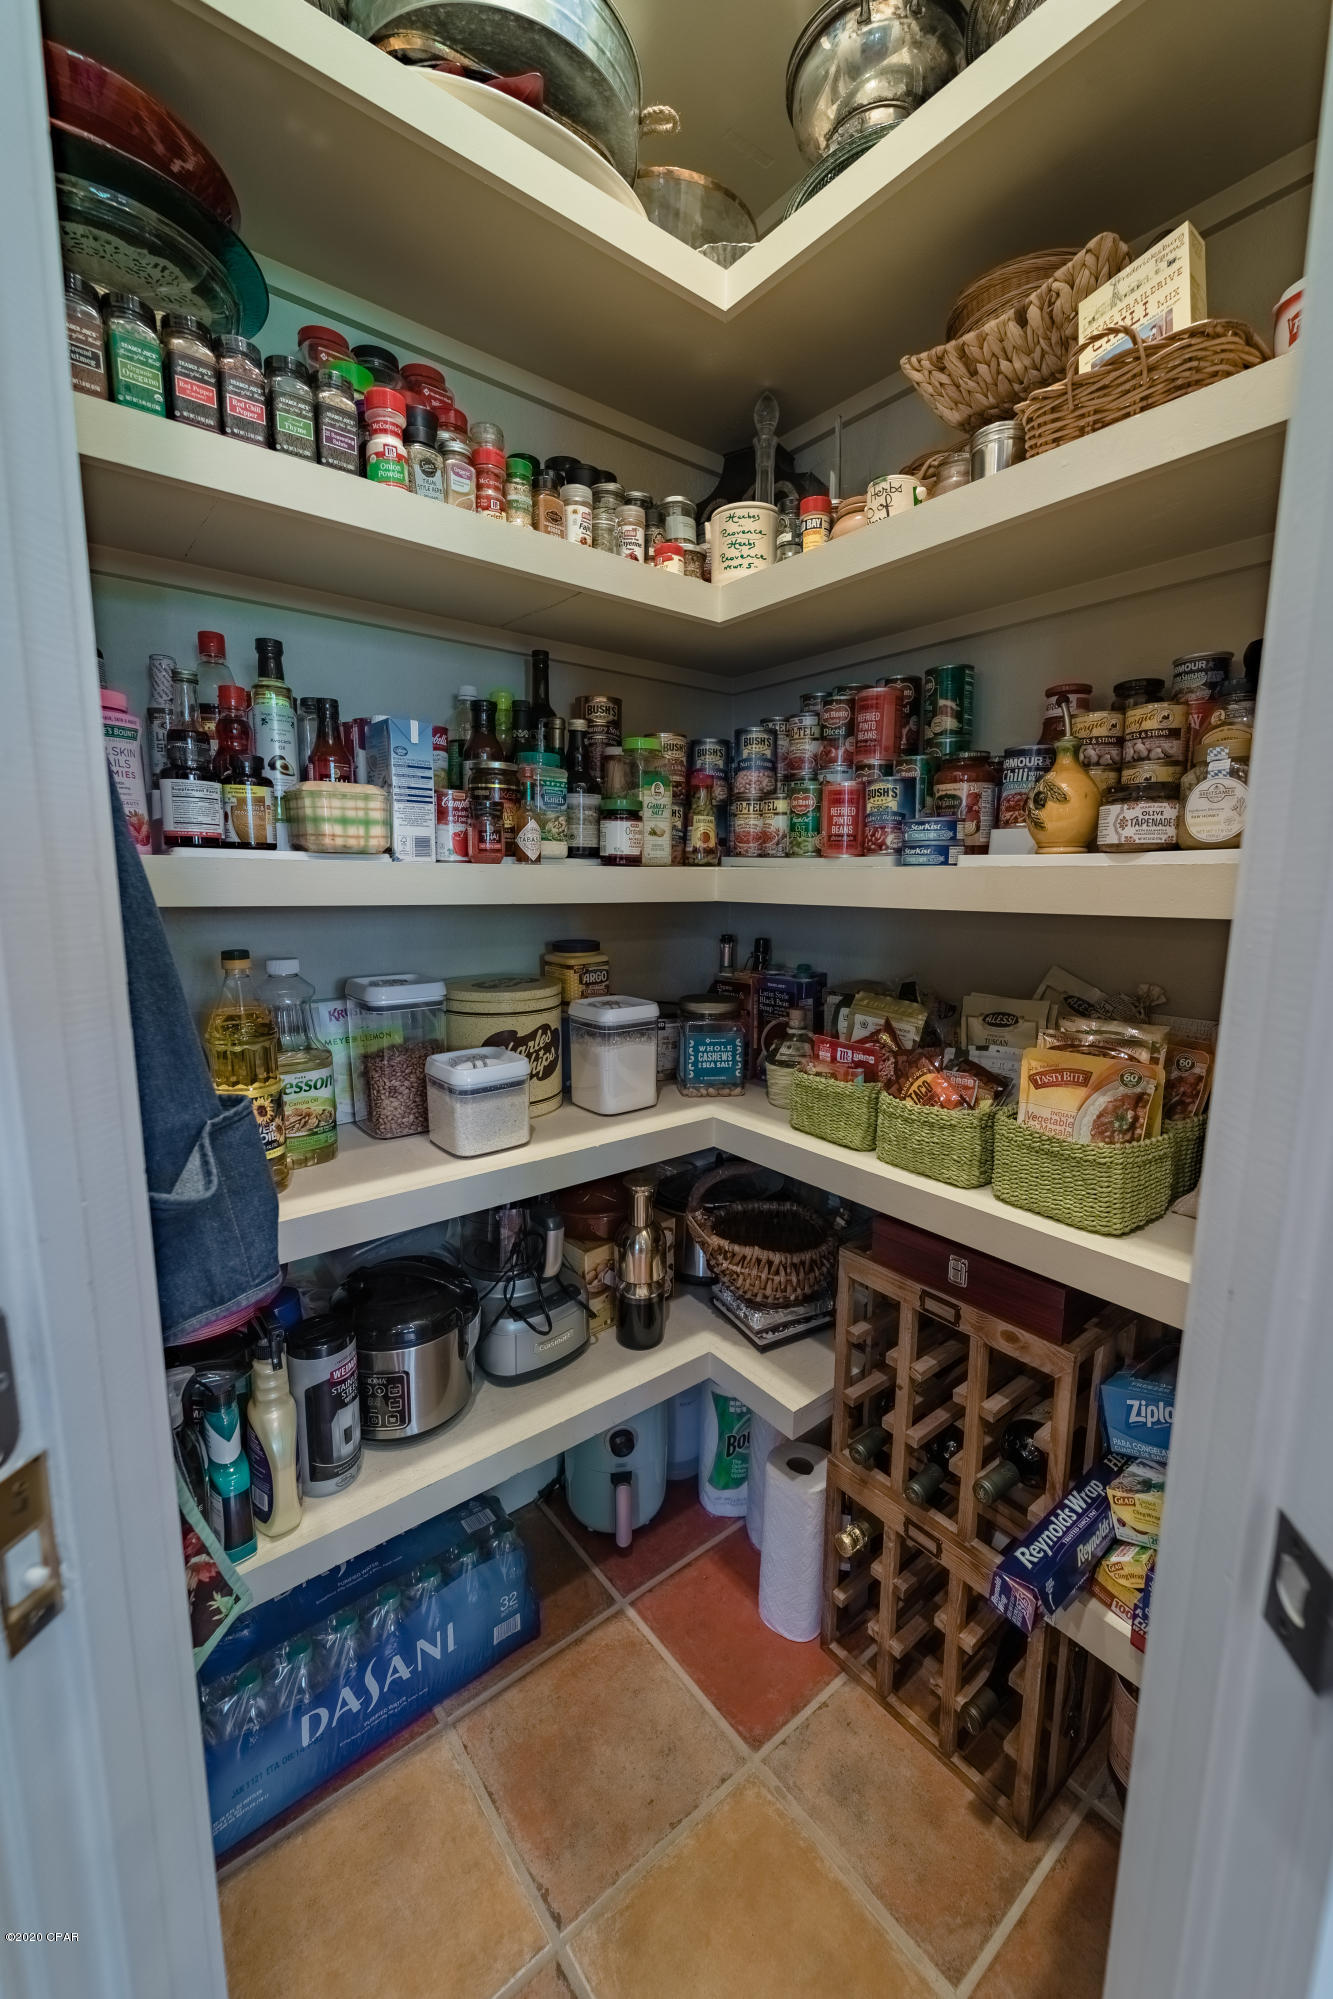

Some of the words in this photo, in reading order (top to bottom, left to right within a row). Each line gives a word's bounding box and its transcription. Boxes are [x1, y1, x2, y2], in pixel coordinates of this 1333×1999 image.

[1118, 266, 1183, 318] TRAILDRIVE
[1157, 286, 1180, 309] MIX
[122, 368, 159, 387] Oregano
[179, 381, 191, 389] Red
[192, 384, 213, 397] Pepper
[232, 400, 246, 409] Red
[246, 402, 262, 413] Chili
[236, 407, 258, 419] Pepper
[284, 422, 307, 435] Thyme
[380, 462, 402, 472] Onion
[378, 470, 404, 480] Powder
[806, 518, 822, 530] BAY
[586, 704, 617, 717] BUSH'S
[857, 711, 881, 722] REFRIED
[823, 726, 846, 737] Diced
[859, 721, 877, 730] PINTO
[113, 728, 138, 739] BOUNTY
[857, 730, 878, 741] BEANS
[1147, 728, 1169, 737] STEMS
[743, 736, 773, 748] BUSH'S
[1098, 736, 1118, 744] STEMS
[112, 746, 136, 758] SKIN
[696, 747, 725, 759] BUSH'S
[112, 769, 137, 780] MIES
[1002, 768, 1028, 783] Chili
[867, 785, 898, 801] BUSH'S
[545, 795, 565, 804] Ranch
[830, 807, 857, 817] REFRIED
[1141, 810, 1165, 818] OLIVE
[832, 816, 853, 826] PINTO
[911, 822, 942, 832] StarKist
[1129, 816, 1173, 829] TAPENADE
[831, 825, 854, 835] BEANS
[904, 846, 932, 856] StarKist
[583, 970, 608, 984] ARGO
[759, 988, 774, 998] Latin
[759, 996, 775, 1005] Black
[985, 1013, 1017, 1026] ALESSI
[984, 1037, 1009, 1047] TUSCAN
[698, 1051, 733, 1061] CASHEWS
[716, 1060, 733, 1068] SALT
[1179, 1058, 1193, 1068] 60
[1034, 1072, 1062, 1085] TASTY
[1062, 1072, 1087, 1084] BITE
[1122, 1073, 1138, 1082] 60
[281, 1074, 333, 1096] esson
[907, 1079, 934, 1106] TACO
[1026, 1111, 1074, 1129] Vegetable
[1127, 1400, 1175, 1428] Ziplo
[1113, 1437, 1132, 1449] PARA
[1132, 1442, 1168, 1456] CONGELA
[1114, 1495, 1136, 1506] GLAD
[1014, 1508, 1078, 1570] Reynolds
[1063, 1479, 1104, 1513] Wrap
[1061, 1526, 1080, 1544] TRUSTED
[1076, 1519, 1109, 1568] Reynolds
[1108, 1562, 1123, 1572] GLAD
[499, 1591, 518, 1612] 32
[1114, 1599, 1133, 1621] 100
[301, 1621, 456, 1748] DASANI
